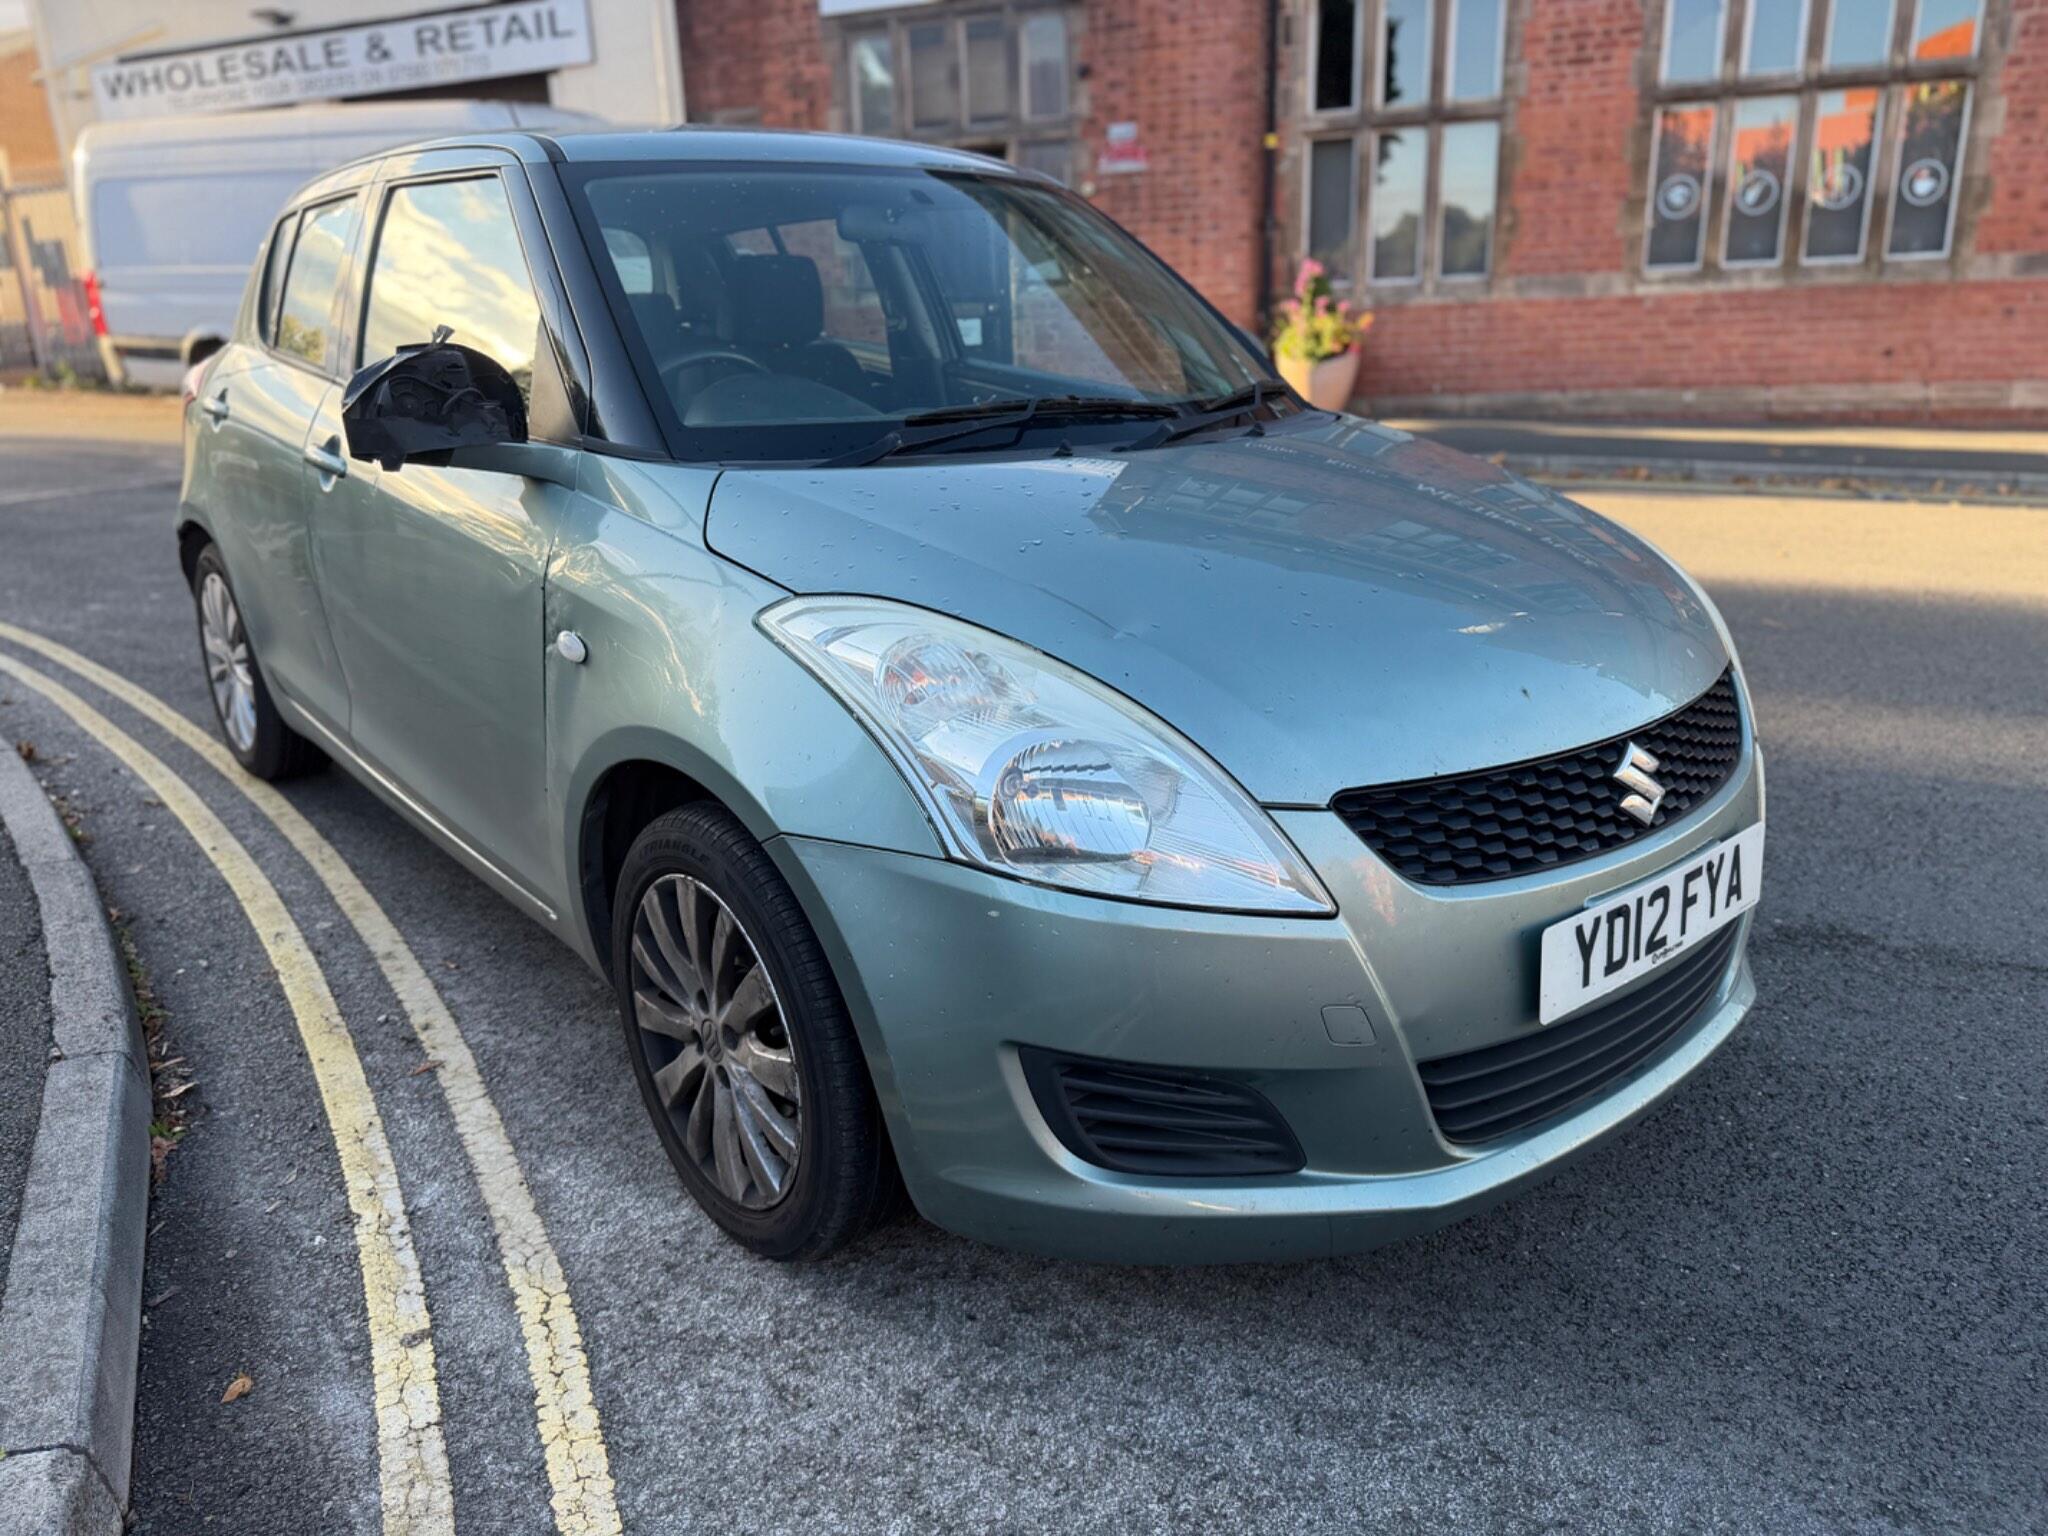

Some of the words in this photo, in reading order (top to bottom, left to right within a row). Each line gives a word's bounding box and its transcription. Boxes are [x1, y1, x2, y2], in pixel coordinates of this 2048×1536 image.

[101, 36, 349, 98] WHOLESALE
[365, 31, 391, 63] &
[414, 9, 575, 56] RETAIL
[1575, 884, 1671, 988] YD12
[1680, 843, 1742, 937] FYA
